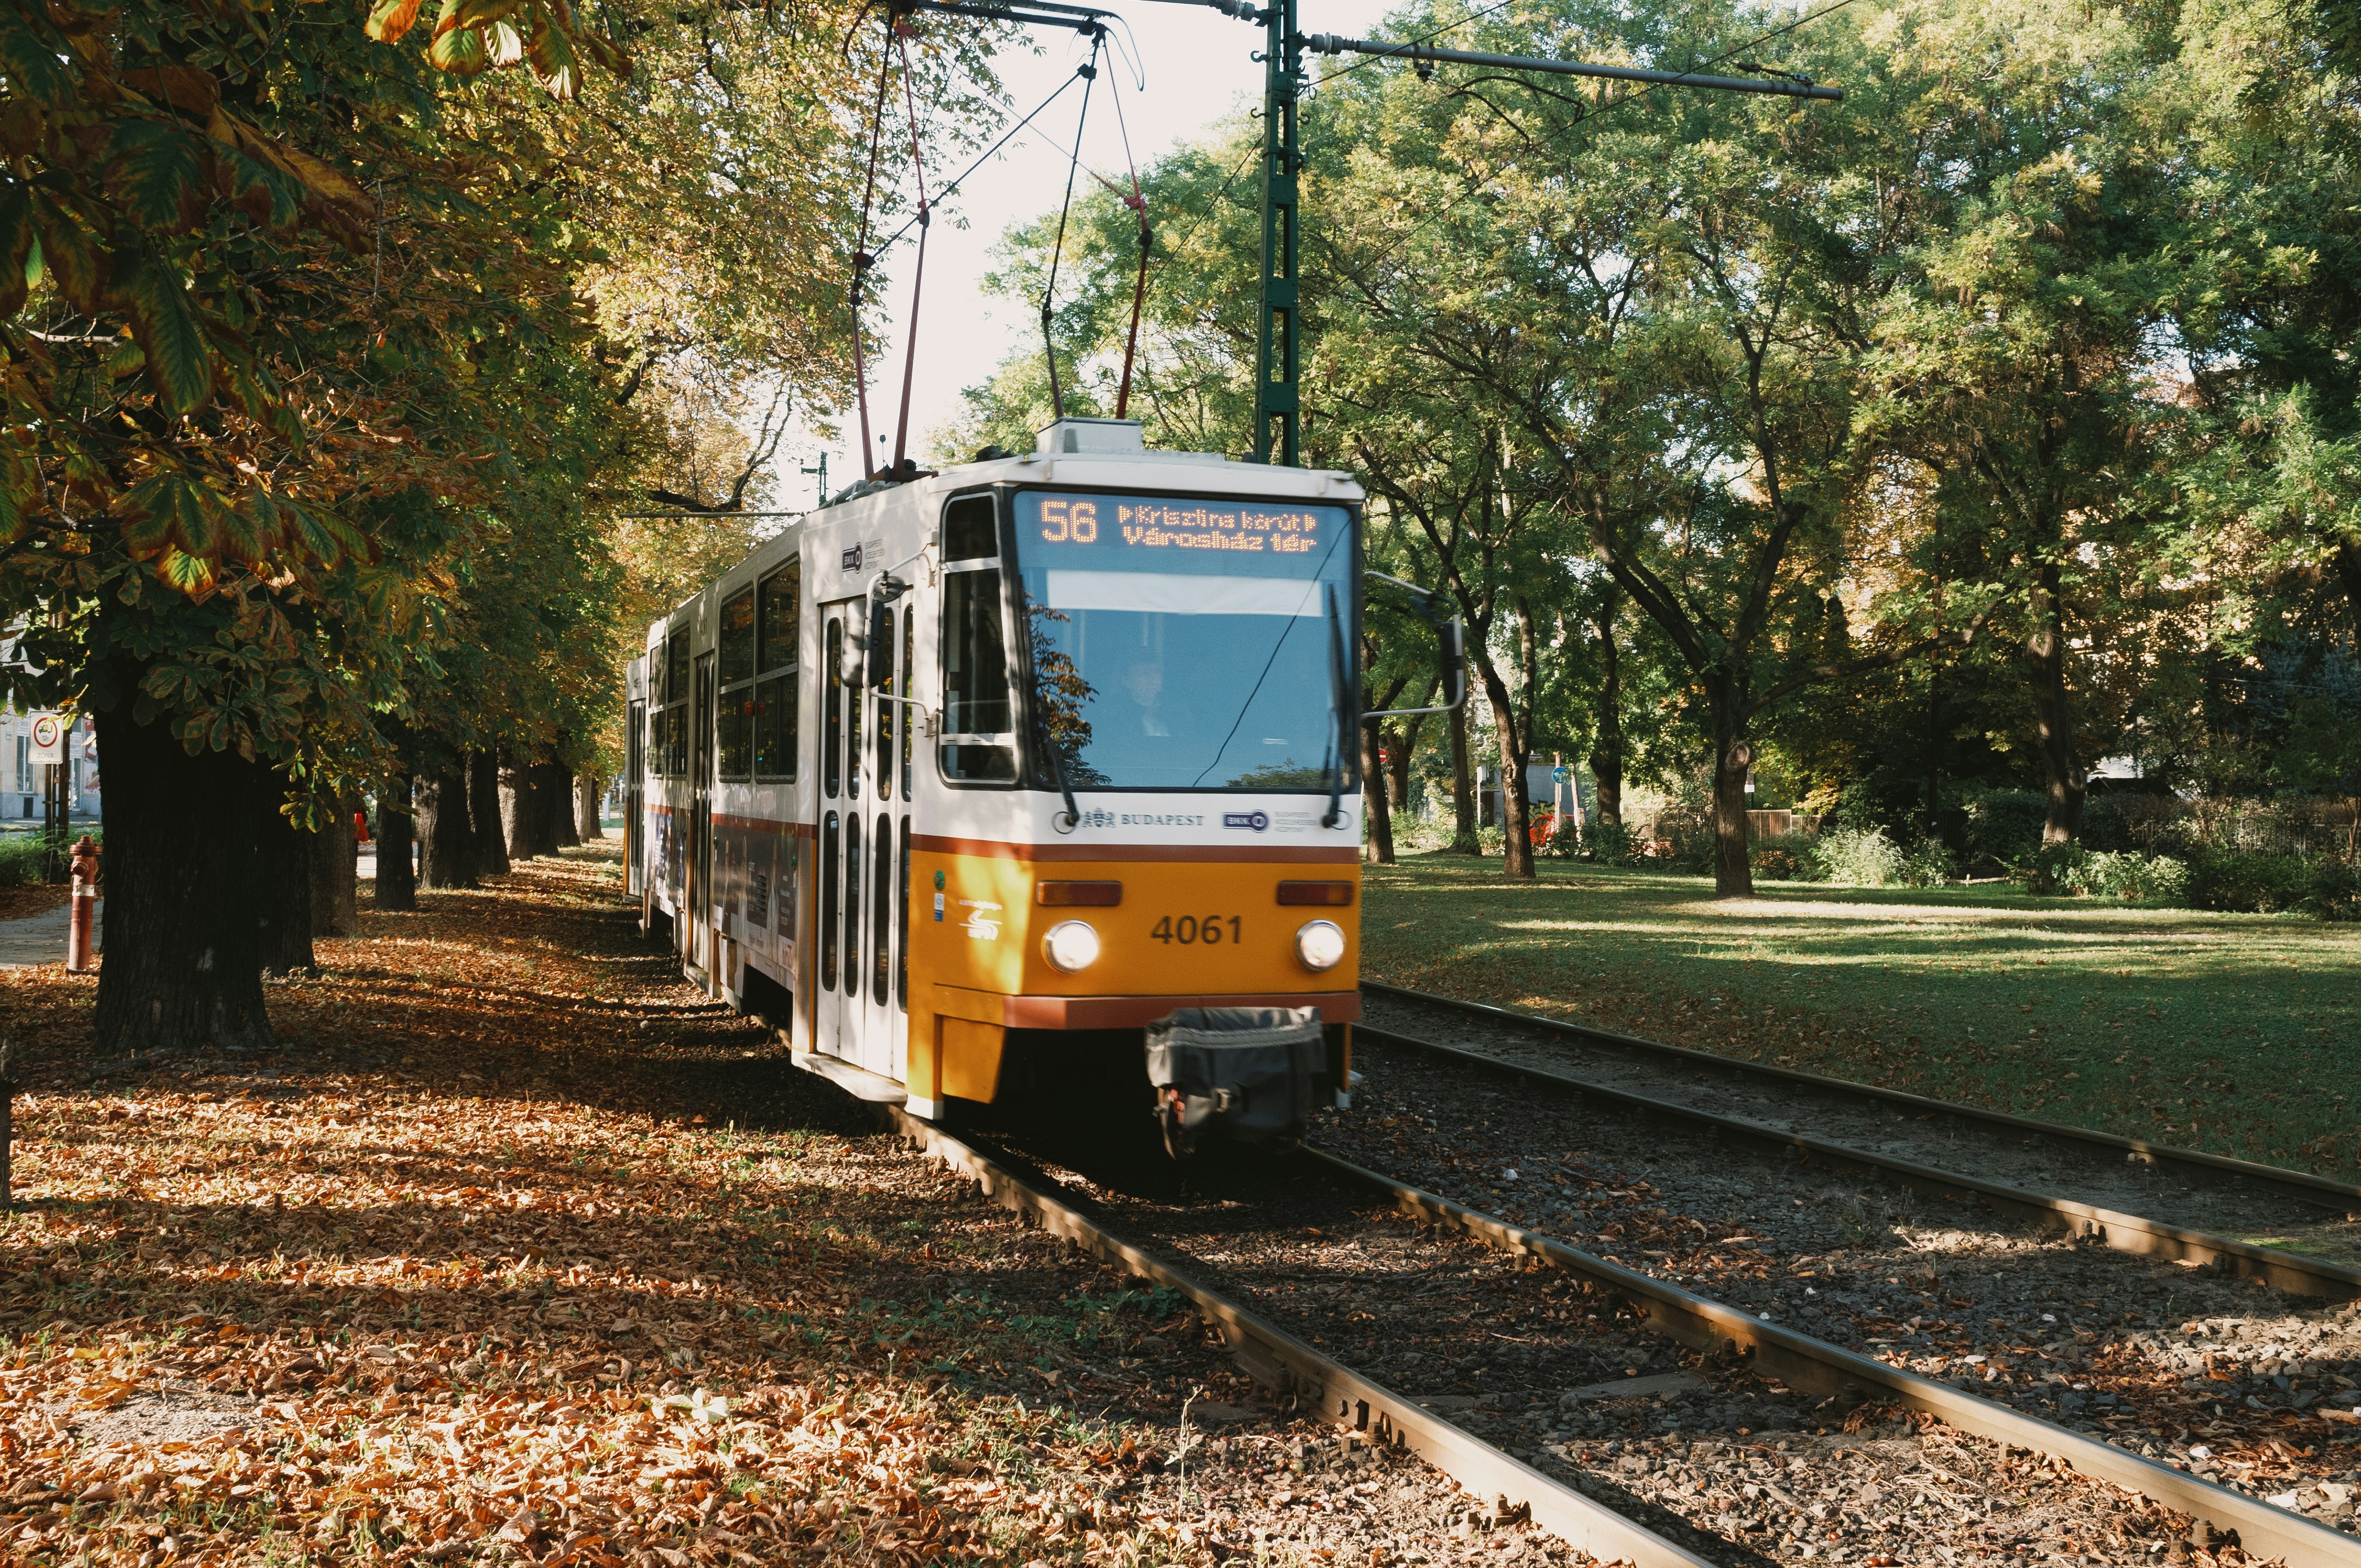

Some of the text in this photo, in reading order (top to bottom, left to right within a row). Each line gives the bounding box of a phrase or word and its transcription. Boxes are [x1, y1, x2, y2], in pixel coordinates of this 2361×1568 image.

[1041, 500, 1097, 543] 56
[1270, 533, 1317, 552] tér
[1121, 814, 1205, 826] BUDAPEST
[1151, 914, 1242, 944] 4061
